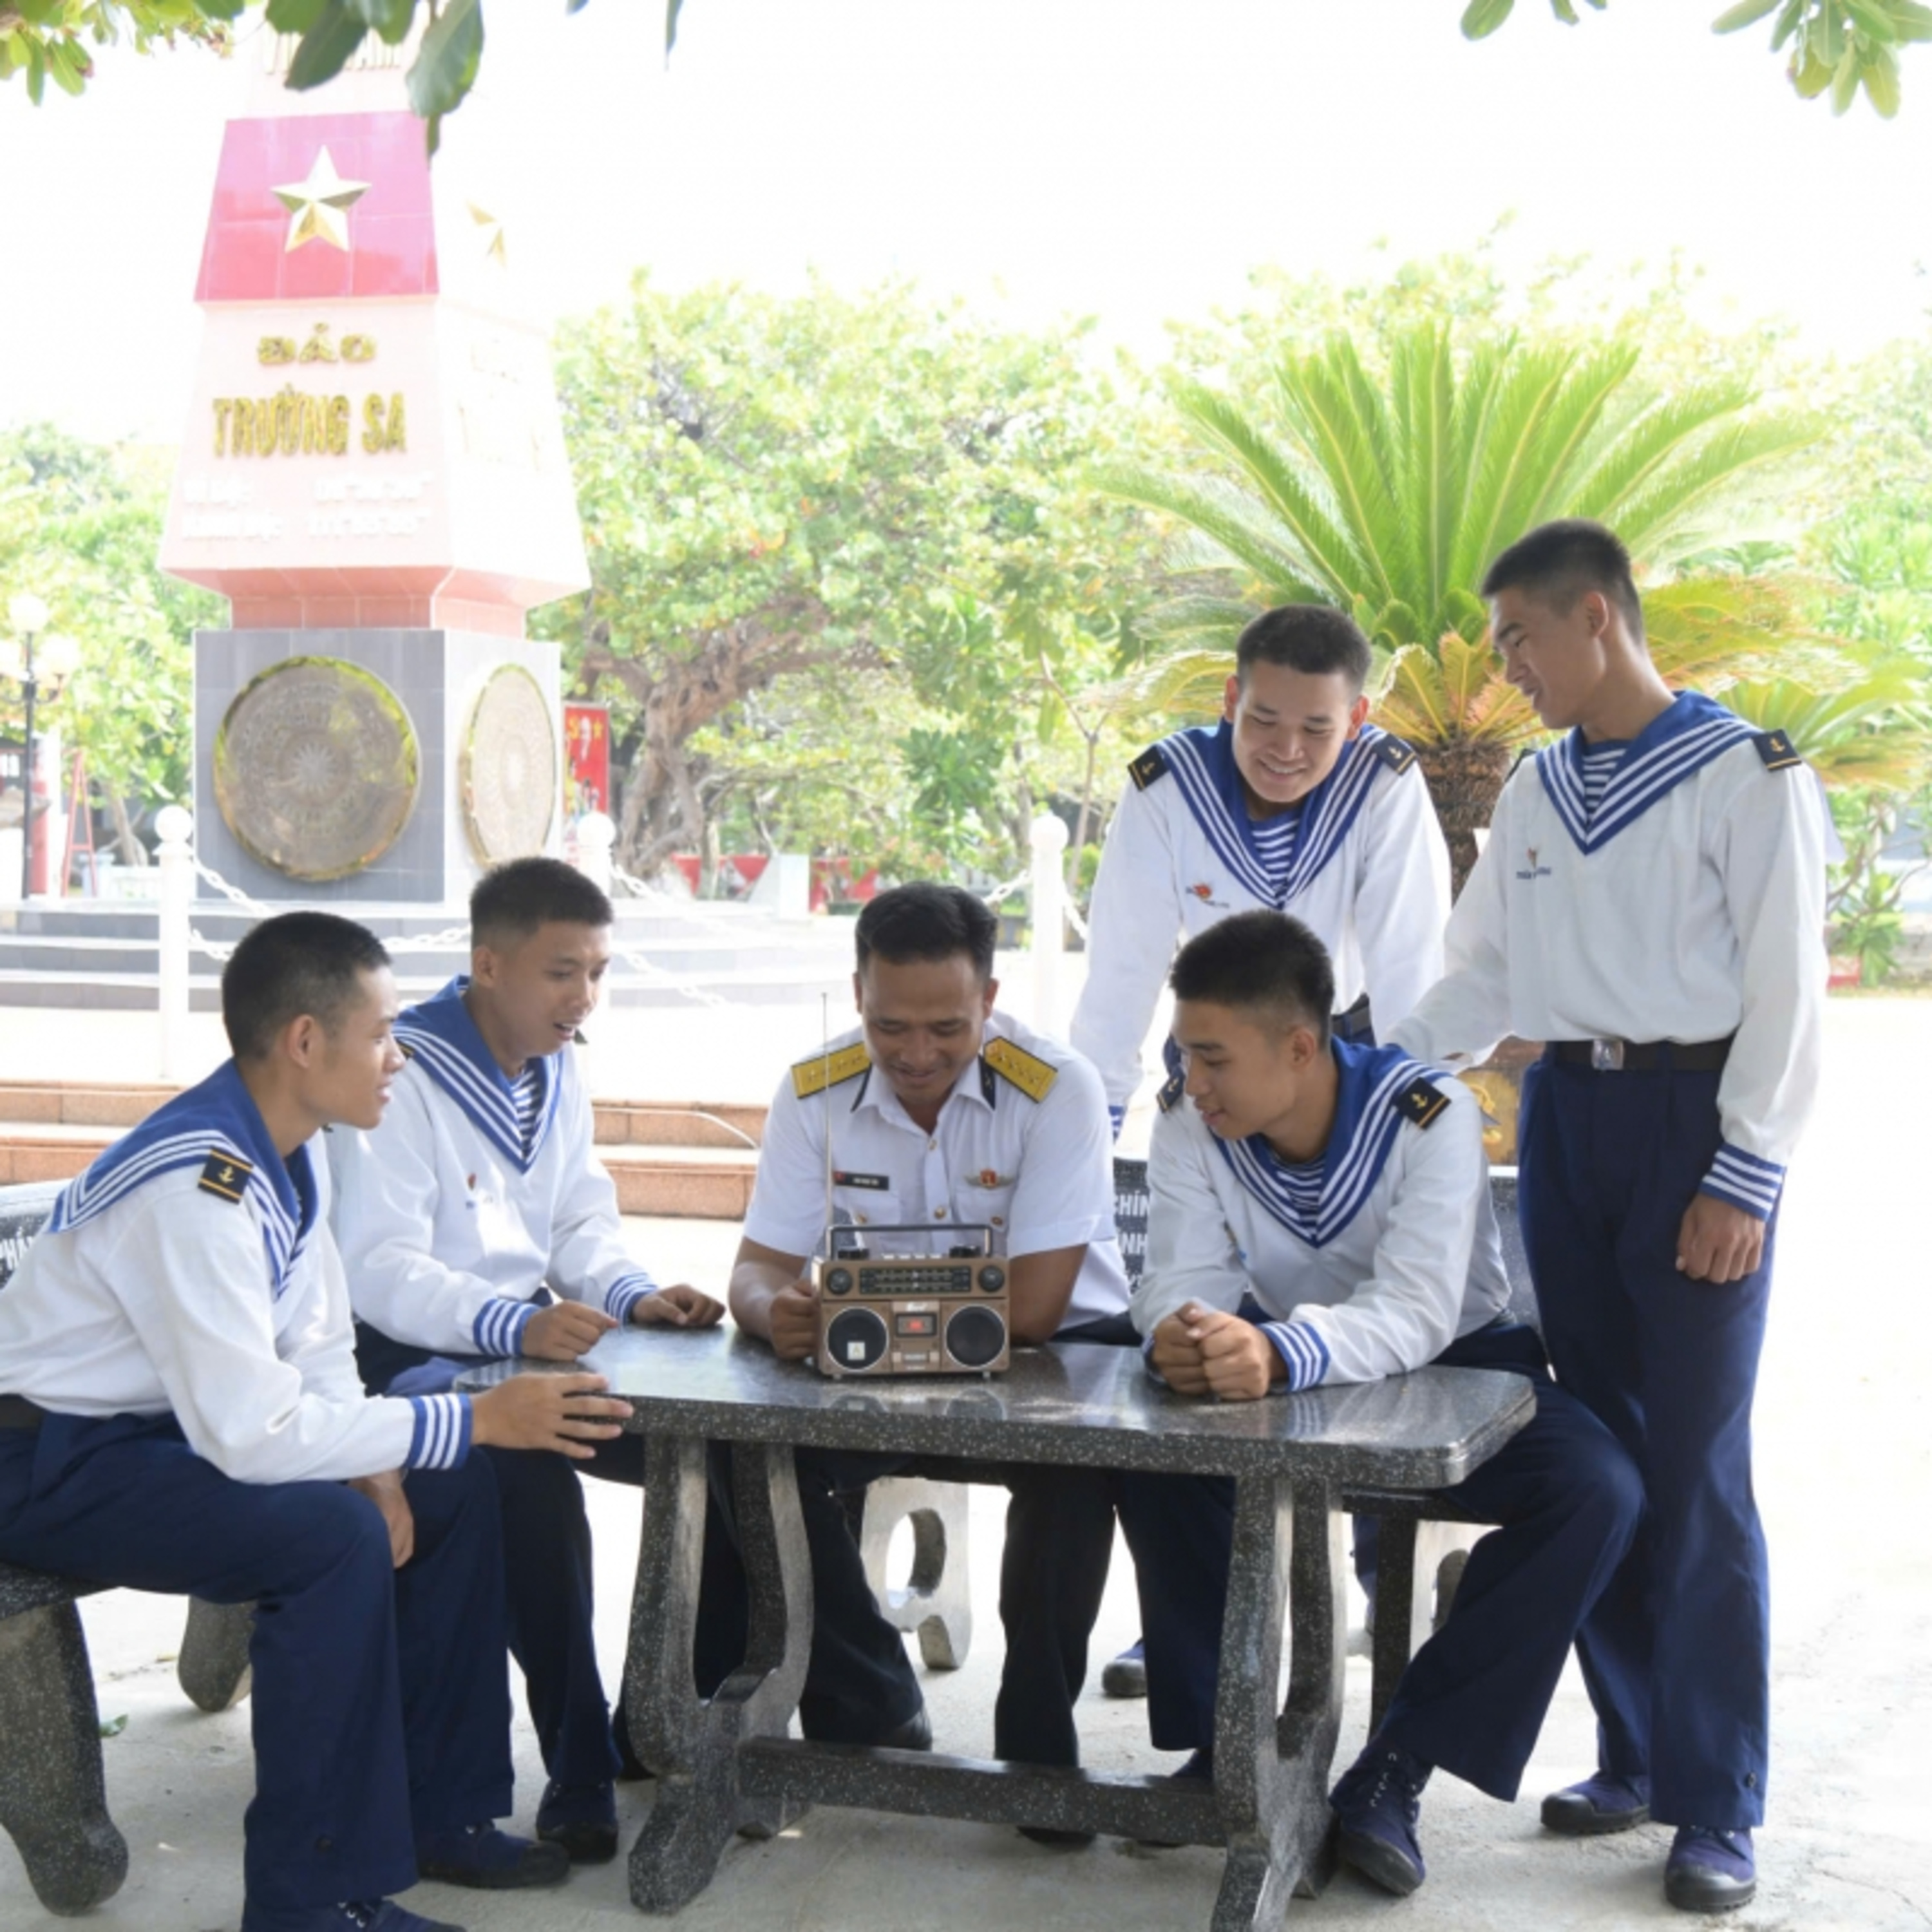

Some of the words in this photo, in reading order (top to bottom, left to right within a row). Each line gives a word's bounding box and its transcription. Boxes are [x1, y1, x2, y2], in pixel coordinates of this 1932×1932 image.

[258, 323, 376, 365] ĐẢO
[213, 383, 350, 456] TRƯỜNG
[362, 392, 406, 454] SA
